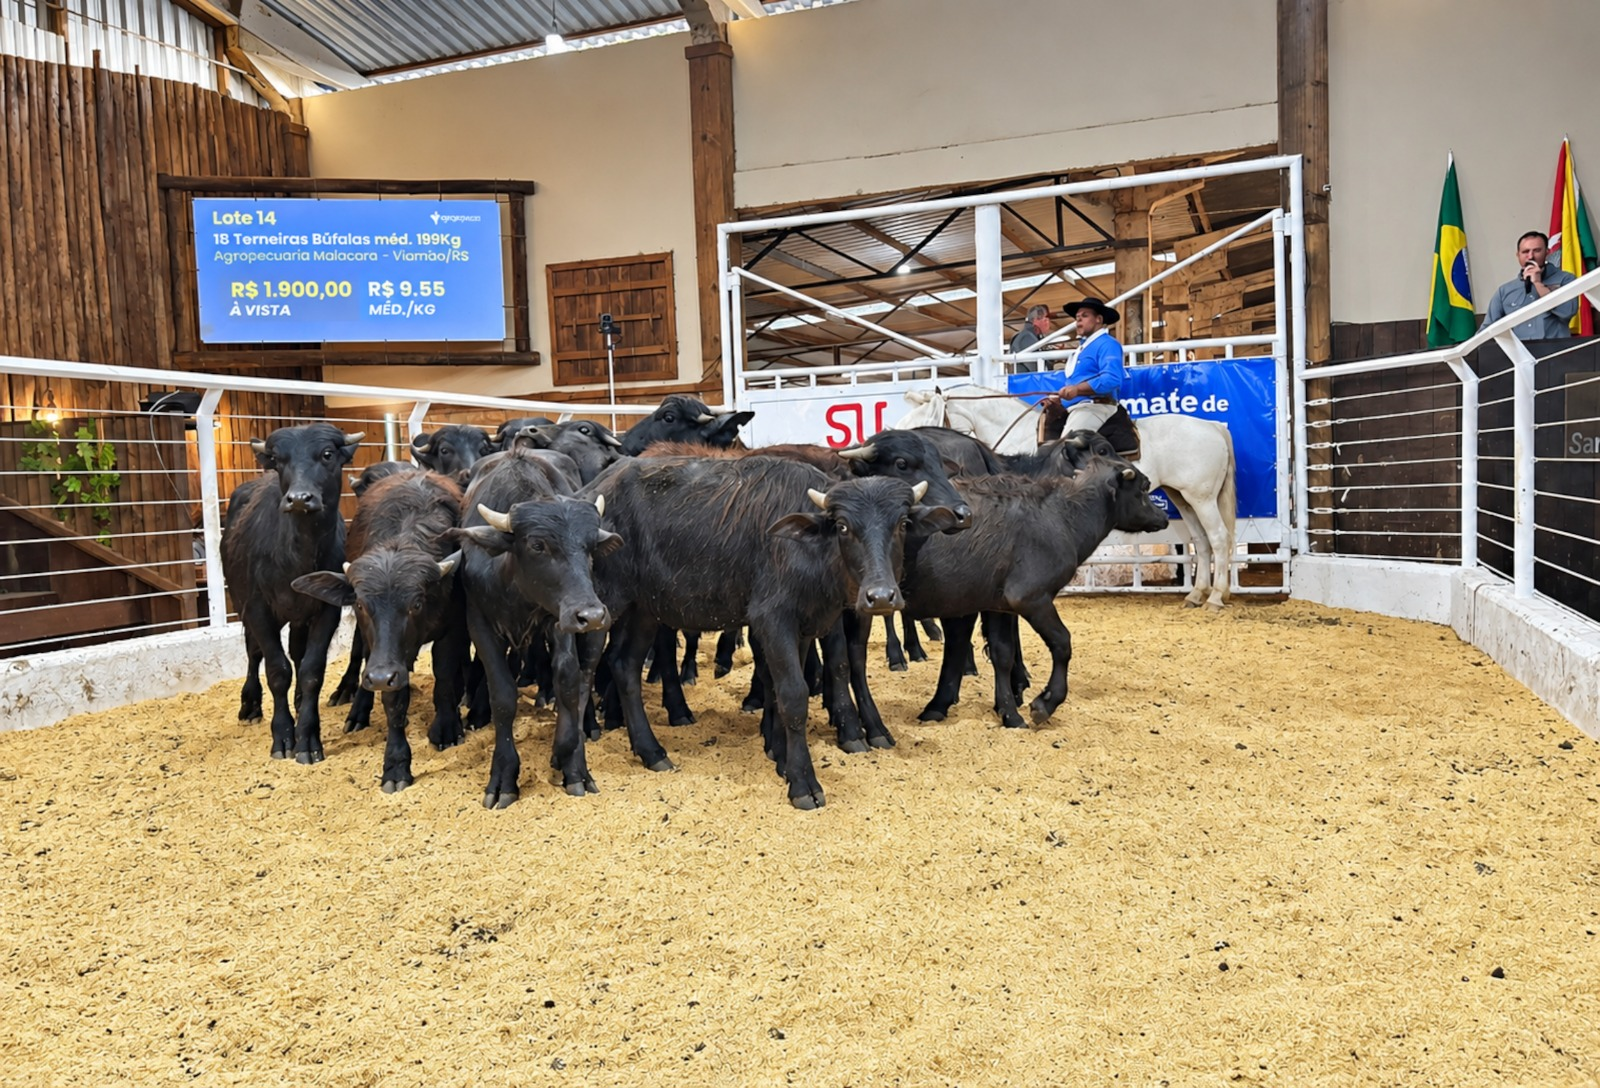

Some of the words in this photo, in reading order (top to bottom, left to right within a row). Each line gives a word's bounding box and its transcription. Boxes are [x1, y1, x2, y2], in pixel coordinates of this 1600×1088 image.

[212, 210, 253, 226] Lote
[256, 210, 277, 226] 14
[213, 233, 230, 245] 18
[233, 232, 309, 245] Terneiras
[312, 232, 371, 245] Búfalas
[374, 232, 413, 246] méd.
[416, 233, 462, 249] 199Kg
[313, 249, 378, 261] Malacara
[231, 280, 259, 300] R$
[263, 280, 352, 300] 1.900,00
[368, 280, 395, 299] R$
[399, 280, 446, 297] 9.55
[229, 301, 242, 316] À
[245, 304, 291, 316] VISTA
[369, 300, 436, 318] MÉD./KG
[1201, 394, 1230, 413] de
